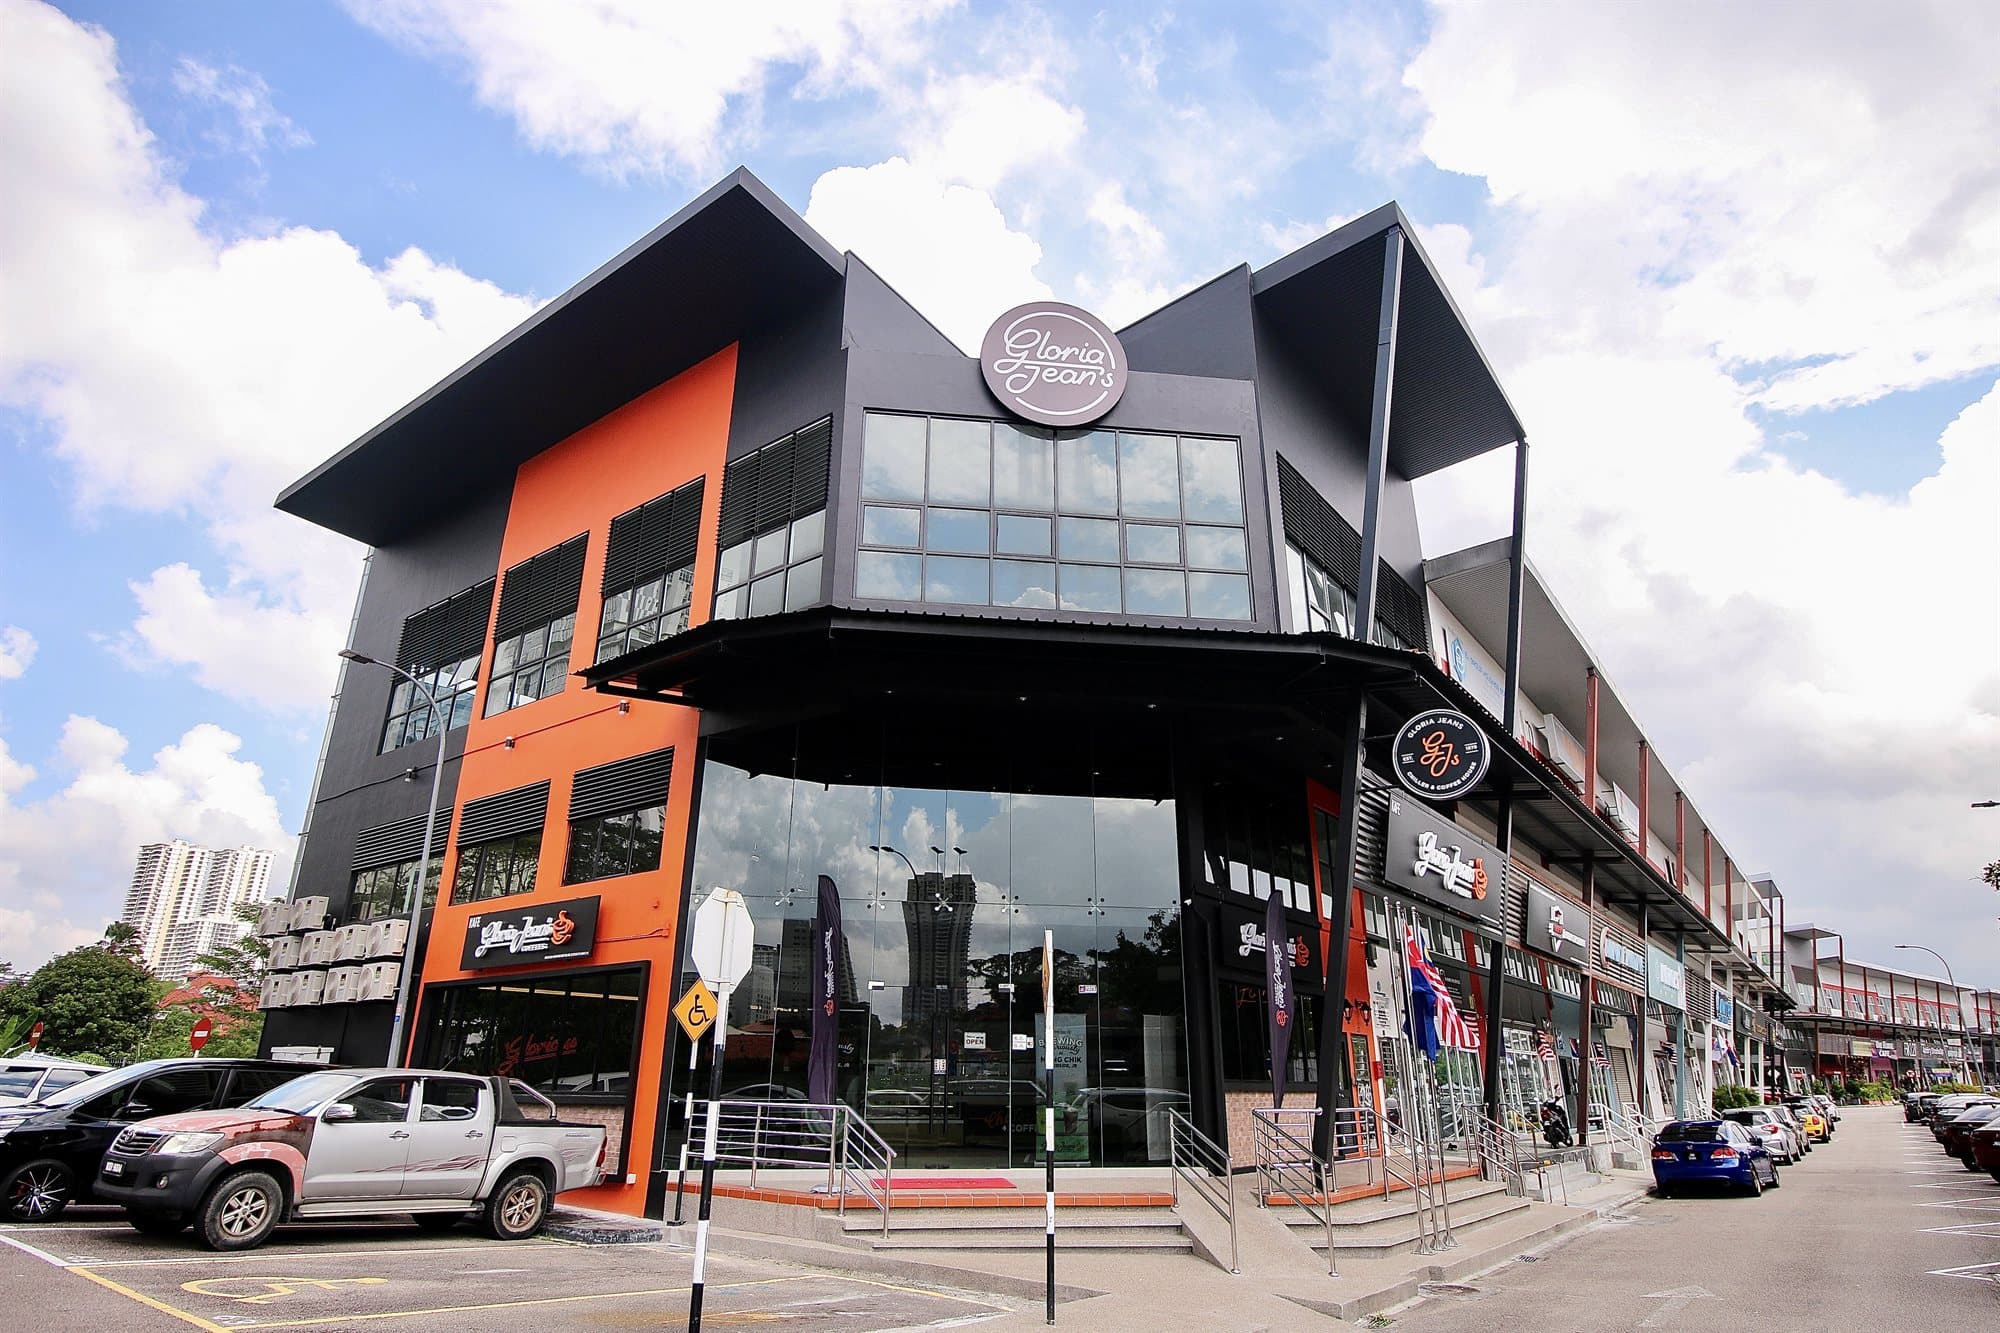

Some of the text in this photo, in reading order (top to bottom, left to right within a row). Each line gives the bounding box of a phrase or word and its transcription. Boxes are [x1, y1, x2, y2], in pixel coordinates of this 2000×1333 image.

[994, 327, 1106, 375] Gloria
[1005, 365, 1114, 394] Jean's
[1407, 717, 1464, 738] GLORIA JEANS
[1407, 771, 1429, 789] CHILLER
[1436, 779, 1462, 790] COFFEE
[1460, 761, 1477, 781] HOUSE
[468, 916, 482, 929] KAFE
[474, 920, 519, 958] Gloria
[1038, 1037, 1083, 1047] BEWING
